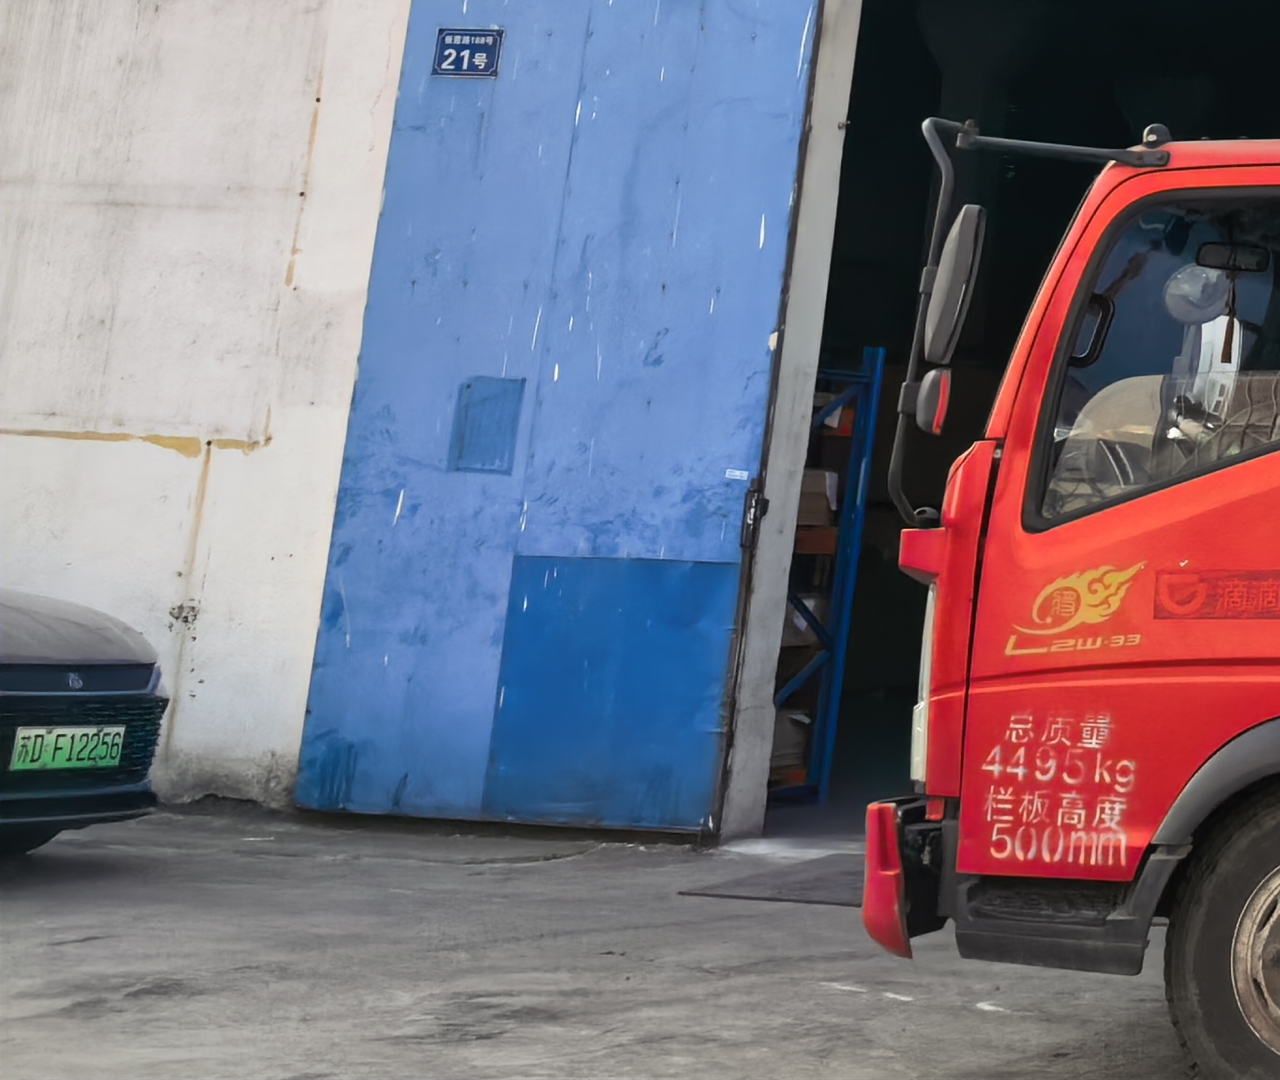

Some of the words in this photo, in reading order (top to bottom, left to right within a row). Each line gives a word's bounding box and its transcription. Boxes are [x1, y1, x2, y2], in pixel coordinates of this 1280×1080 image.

[441, 48, 488, 70] 21号
[1004, 713, 1112, 749] 总质量
[981, 745, 1136, 793] 4495kg
[984, 785, 1127, 830] 栏板高度
[989, 824, 1126, 866] 500mm
